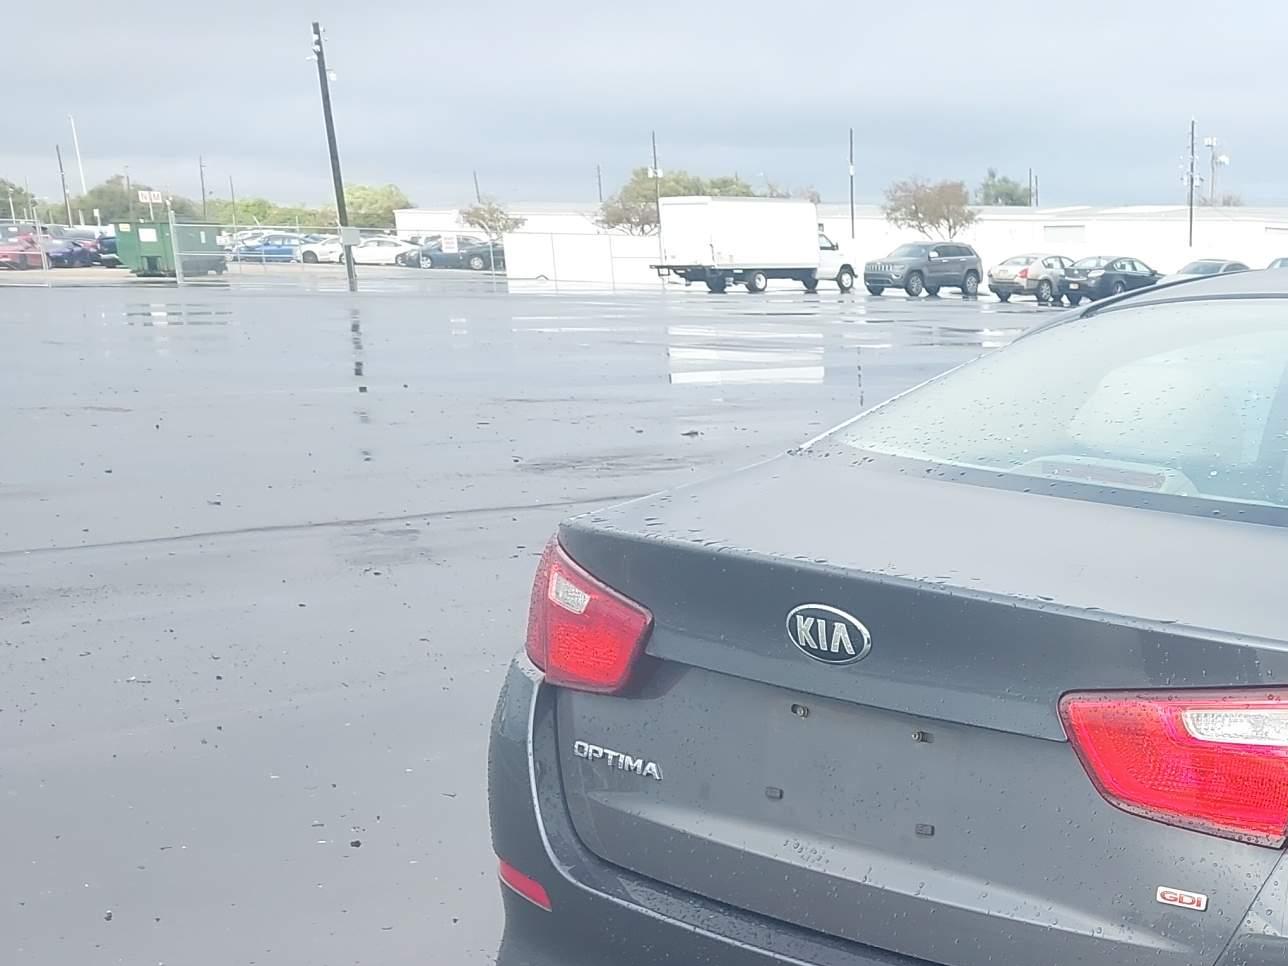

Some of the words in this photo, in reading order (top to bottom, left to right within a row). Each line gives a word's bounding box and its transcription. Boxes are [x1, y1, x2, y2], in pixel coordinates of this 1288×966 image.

[796, 614, 856, 655] KIA
[573, 740, 664, 780] OPTIMA
[1160, 890, 1202, 908] GDI
